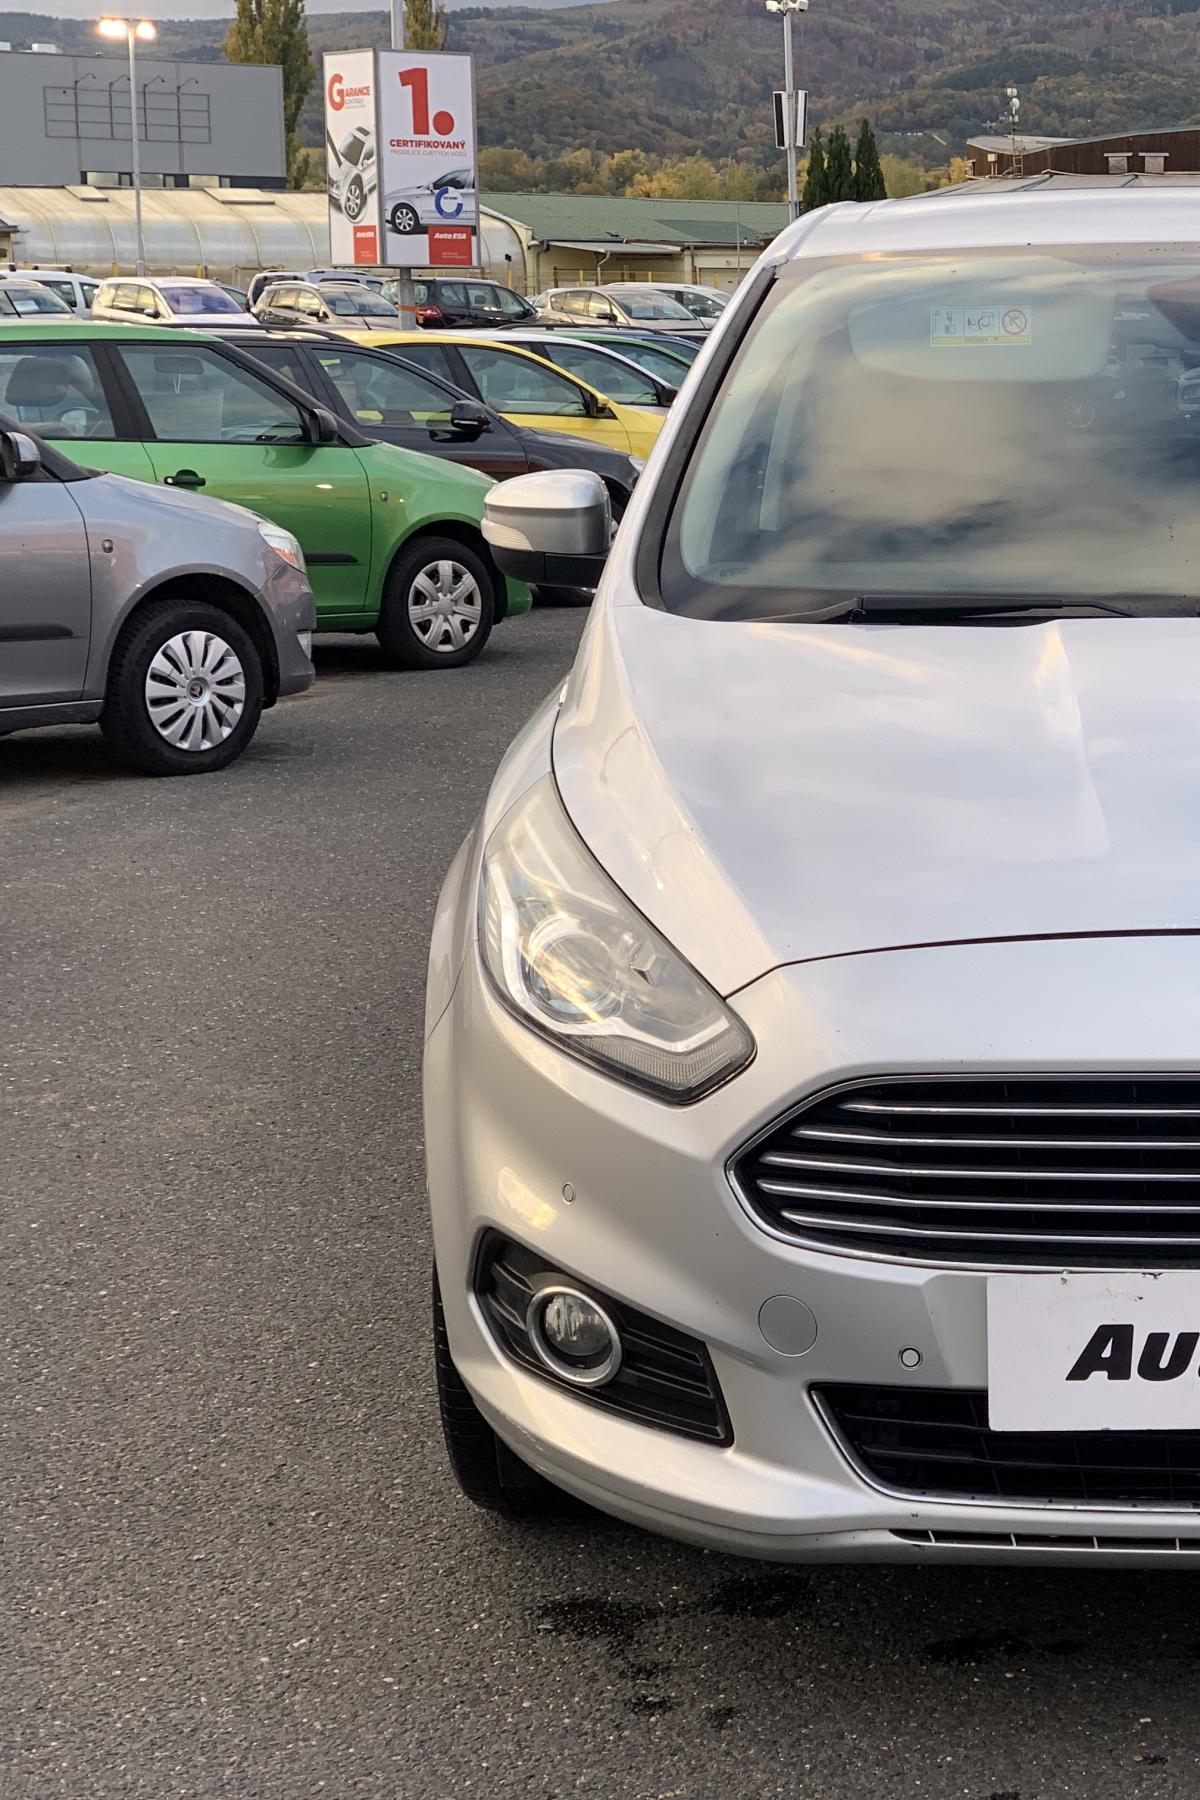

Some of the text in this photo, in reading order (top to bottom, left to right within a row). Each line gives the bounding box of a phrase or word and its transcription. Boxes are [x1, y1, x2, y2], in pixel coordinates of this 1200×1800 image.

[398, 67, 455, 136] 1.
[389, 138, 466, 150] CERTIFIKOVANÝ
[434, 232, 453, 240] Auto
